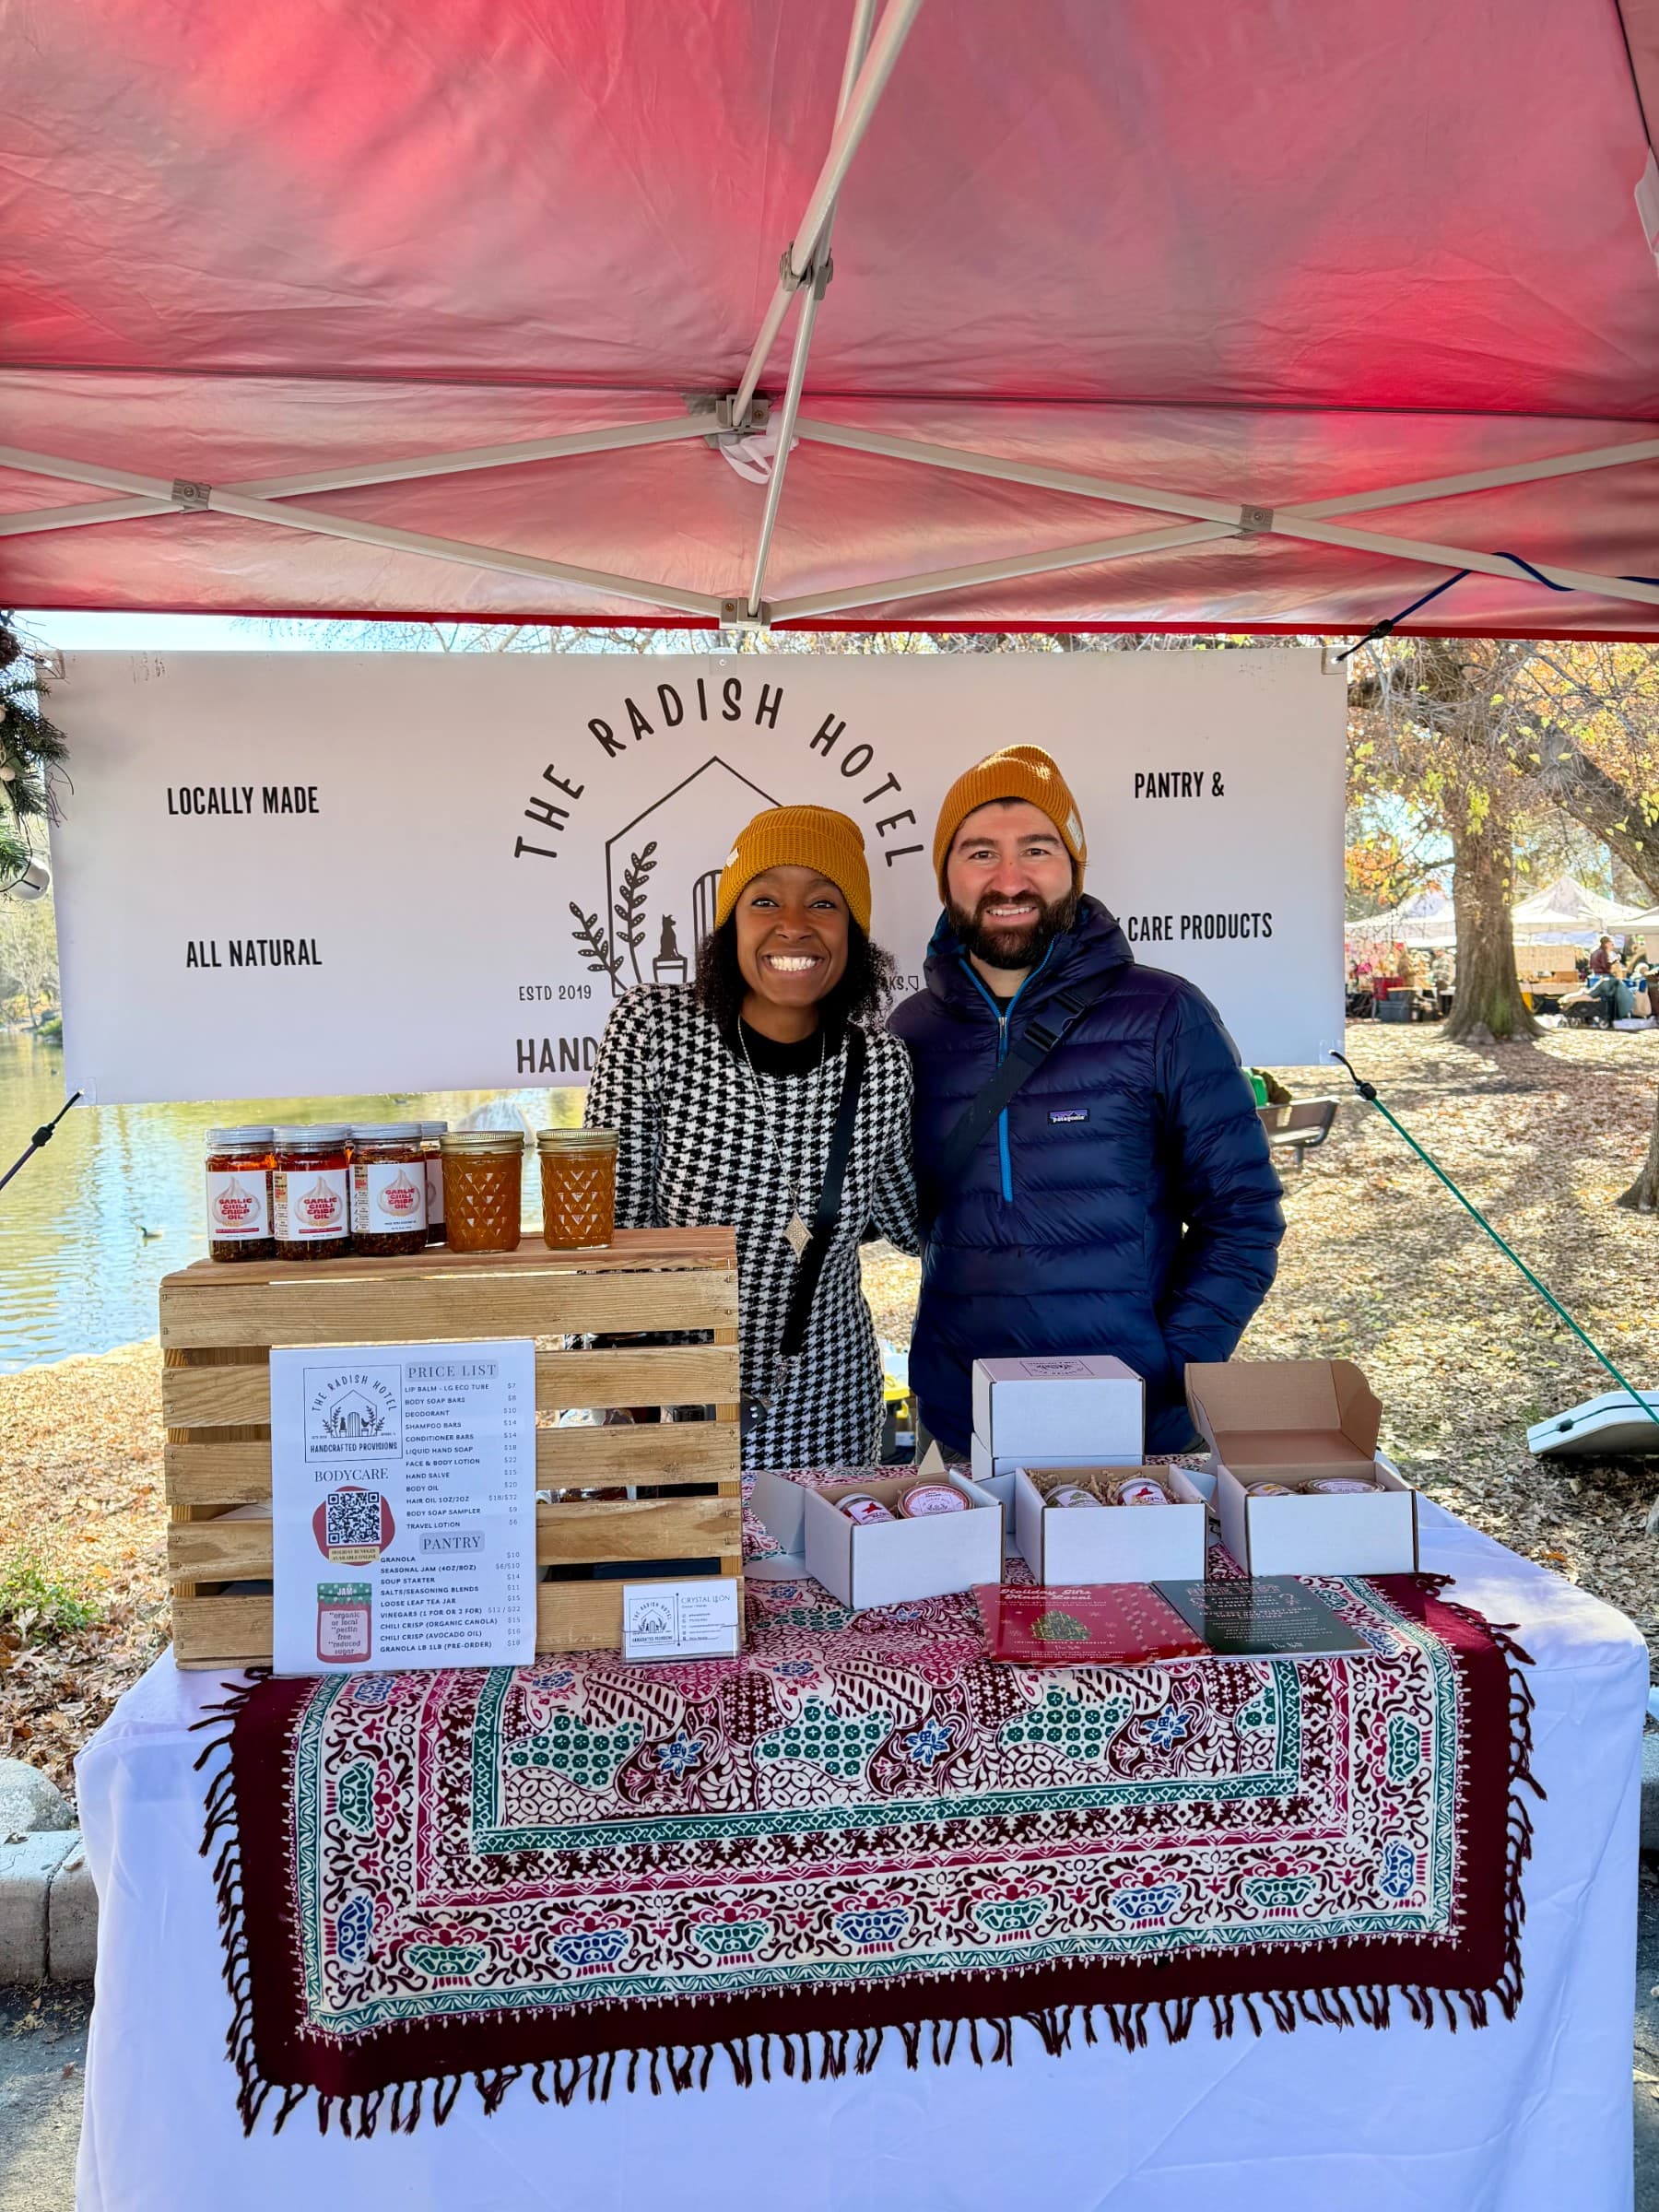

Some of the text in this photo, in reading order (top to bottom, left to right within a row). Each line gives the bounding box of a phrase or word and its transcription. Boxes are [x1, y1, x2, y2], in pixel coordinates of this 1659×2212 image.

[514, 677, 924, 867] THE RADISH HOTEL
[1135, 771, 1225, 798] PANTRY &
[167, 786, 320, 815] LOCALLY MADE
[1127, 912, 1273, 942] CARE PRODUCTS
[186, 938, 323, 968] ALL NATURAL
[519, 985, 592, 1001] ESTD 2019
[408, 1364, 497, 1378] PRICE LIST
[312, 1374, 397, 1411] THE RADISH HOTEL
[311, 1441, 397, 1453] HANDCRAFTED PROVISIONS
[406, 1447, 430, 1455] LIQUID
[315, 1467, 388, 1482] BODYCARE
[423, 1536, 481, 1550] PANTRY
[337, 1588, 353, 1596] JAM
[380, 1587, 449, 1596] SALTS/SEASONING
[681, 1596, 711, 1605] CRYSTAL
[426, 1619, 463, 1629] (ORGANIC
[465, 1618, 498, 1626] CANOLA)
[426, 1631, 465, 1640] (AVOCADO
[443, 1641, 492, 1651] (PRE-ORDER)
